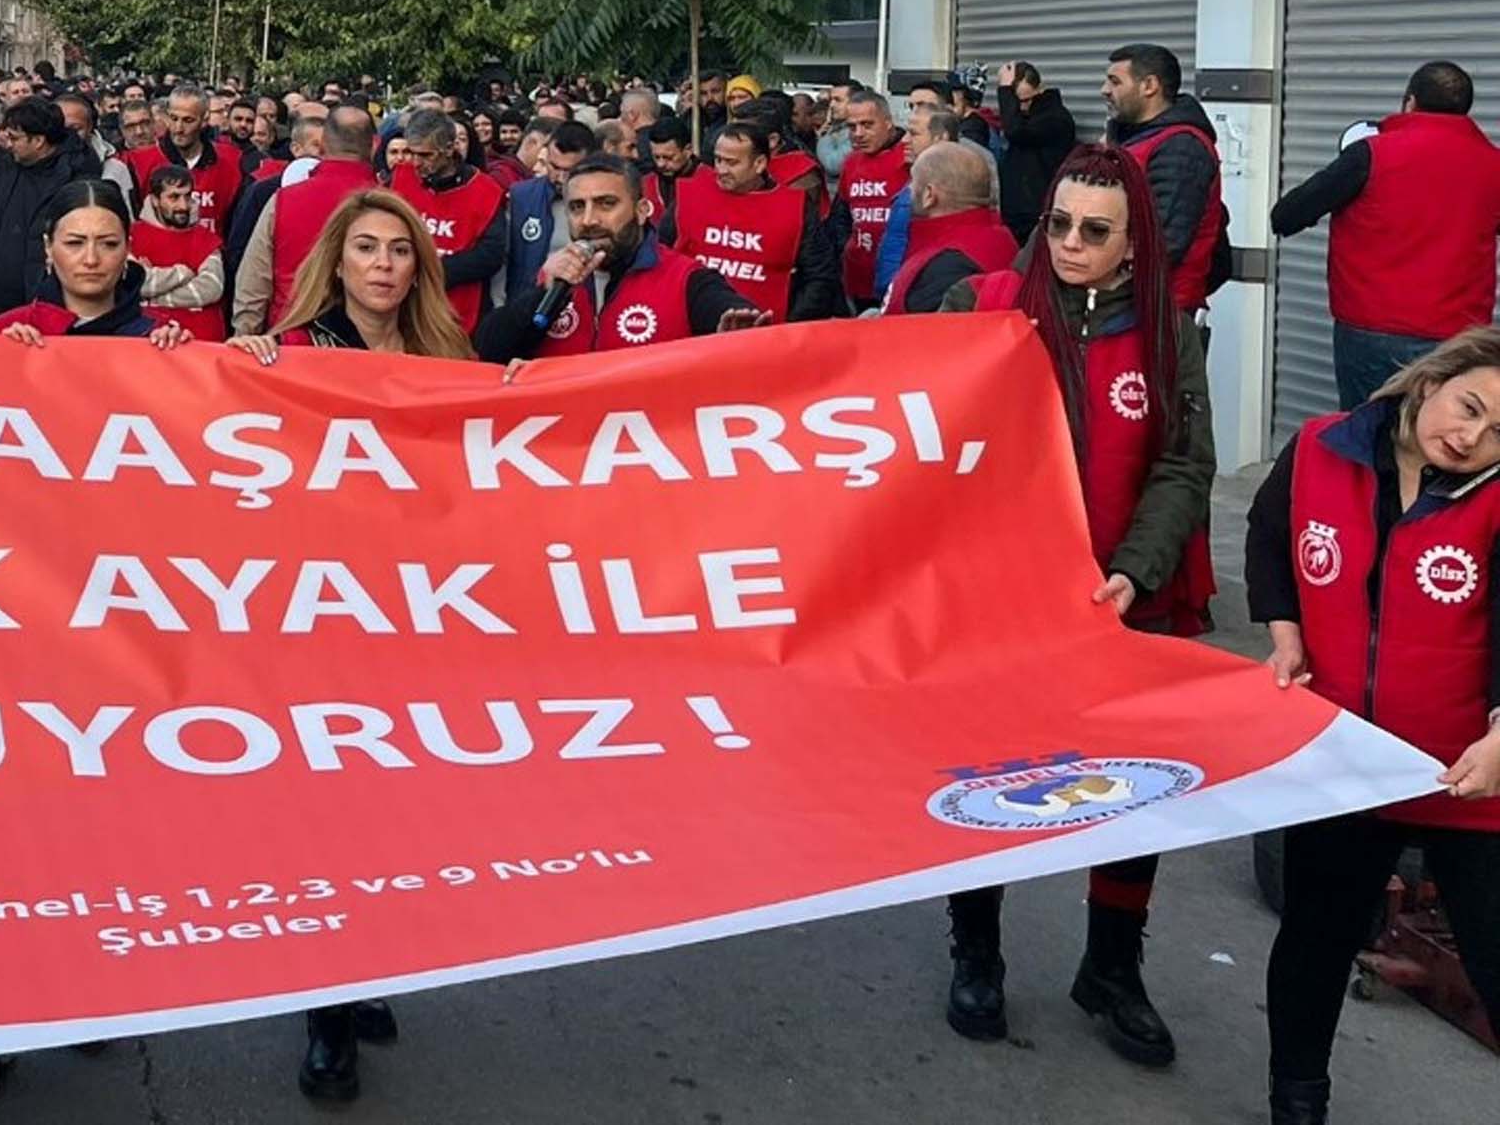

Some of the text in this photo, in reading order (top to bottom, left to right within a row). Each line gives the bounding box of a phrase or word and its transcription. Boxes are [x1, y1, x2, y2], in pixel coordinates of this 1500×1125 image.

[849, 178, 887, 197] DİSK
[704, 224, 764, 252] DİSK
[464, 391, 985, 490] KARŞI,
[69, 554, 516, 633] AYAK
[547, 542, 797, 634] İLE
[1430, 563, 1466, 582] DİSK
[686, 696, 751, 749] !
[185, 879, 337, 909] 1,2,3
[352, 873, 426, 894] ve
[438, 865, 477, 886] 9
[490, 847, 654, 880] No'lu
[97, 912, 349, 955] Şubeler
